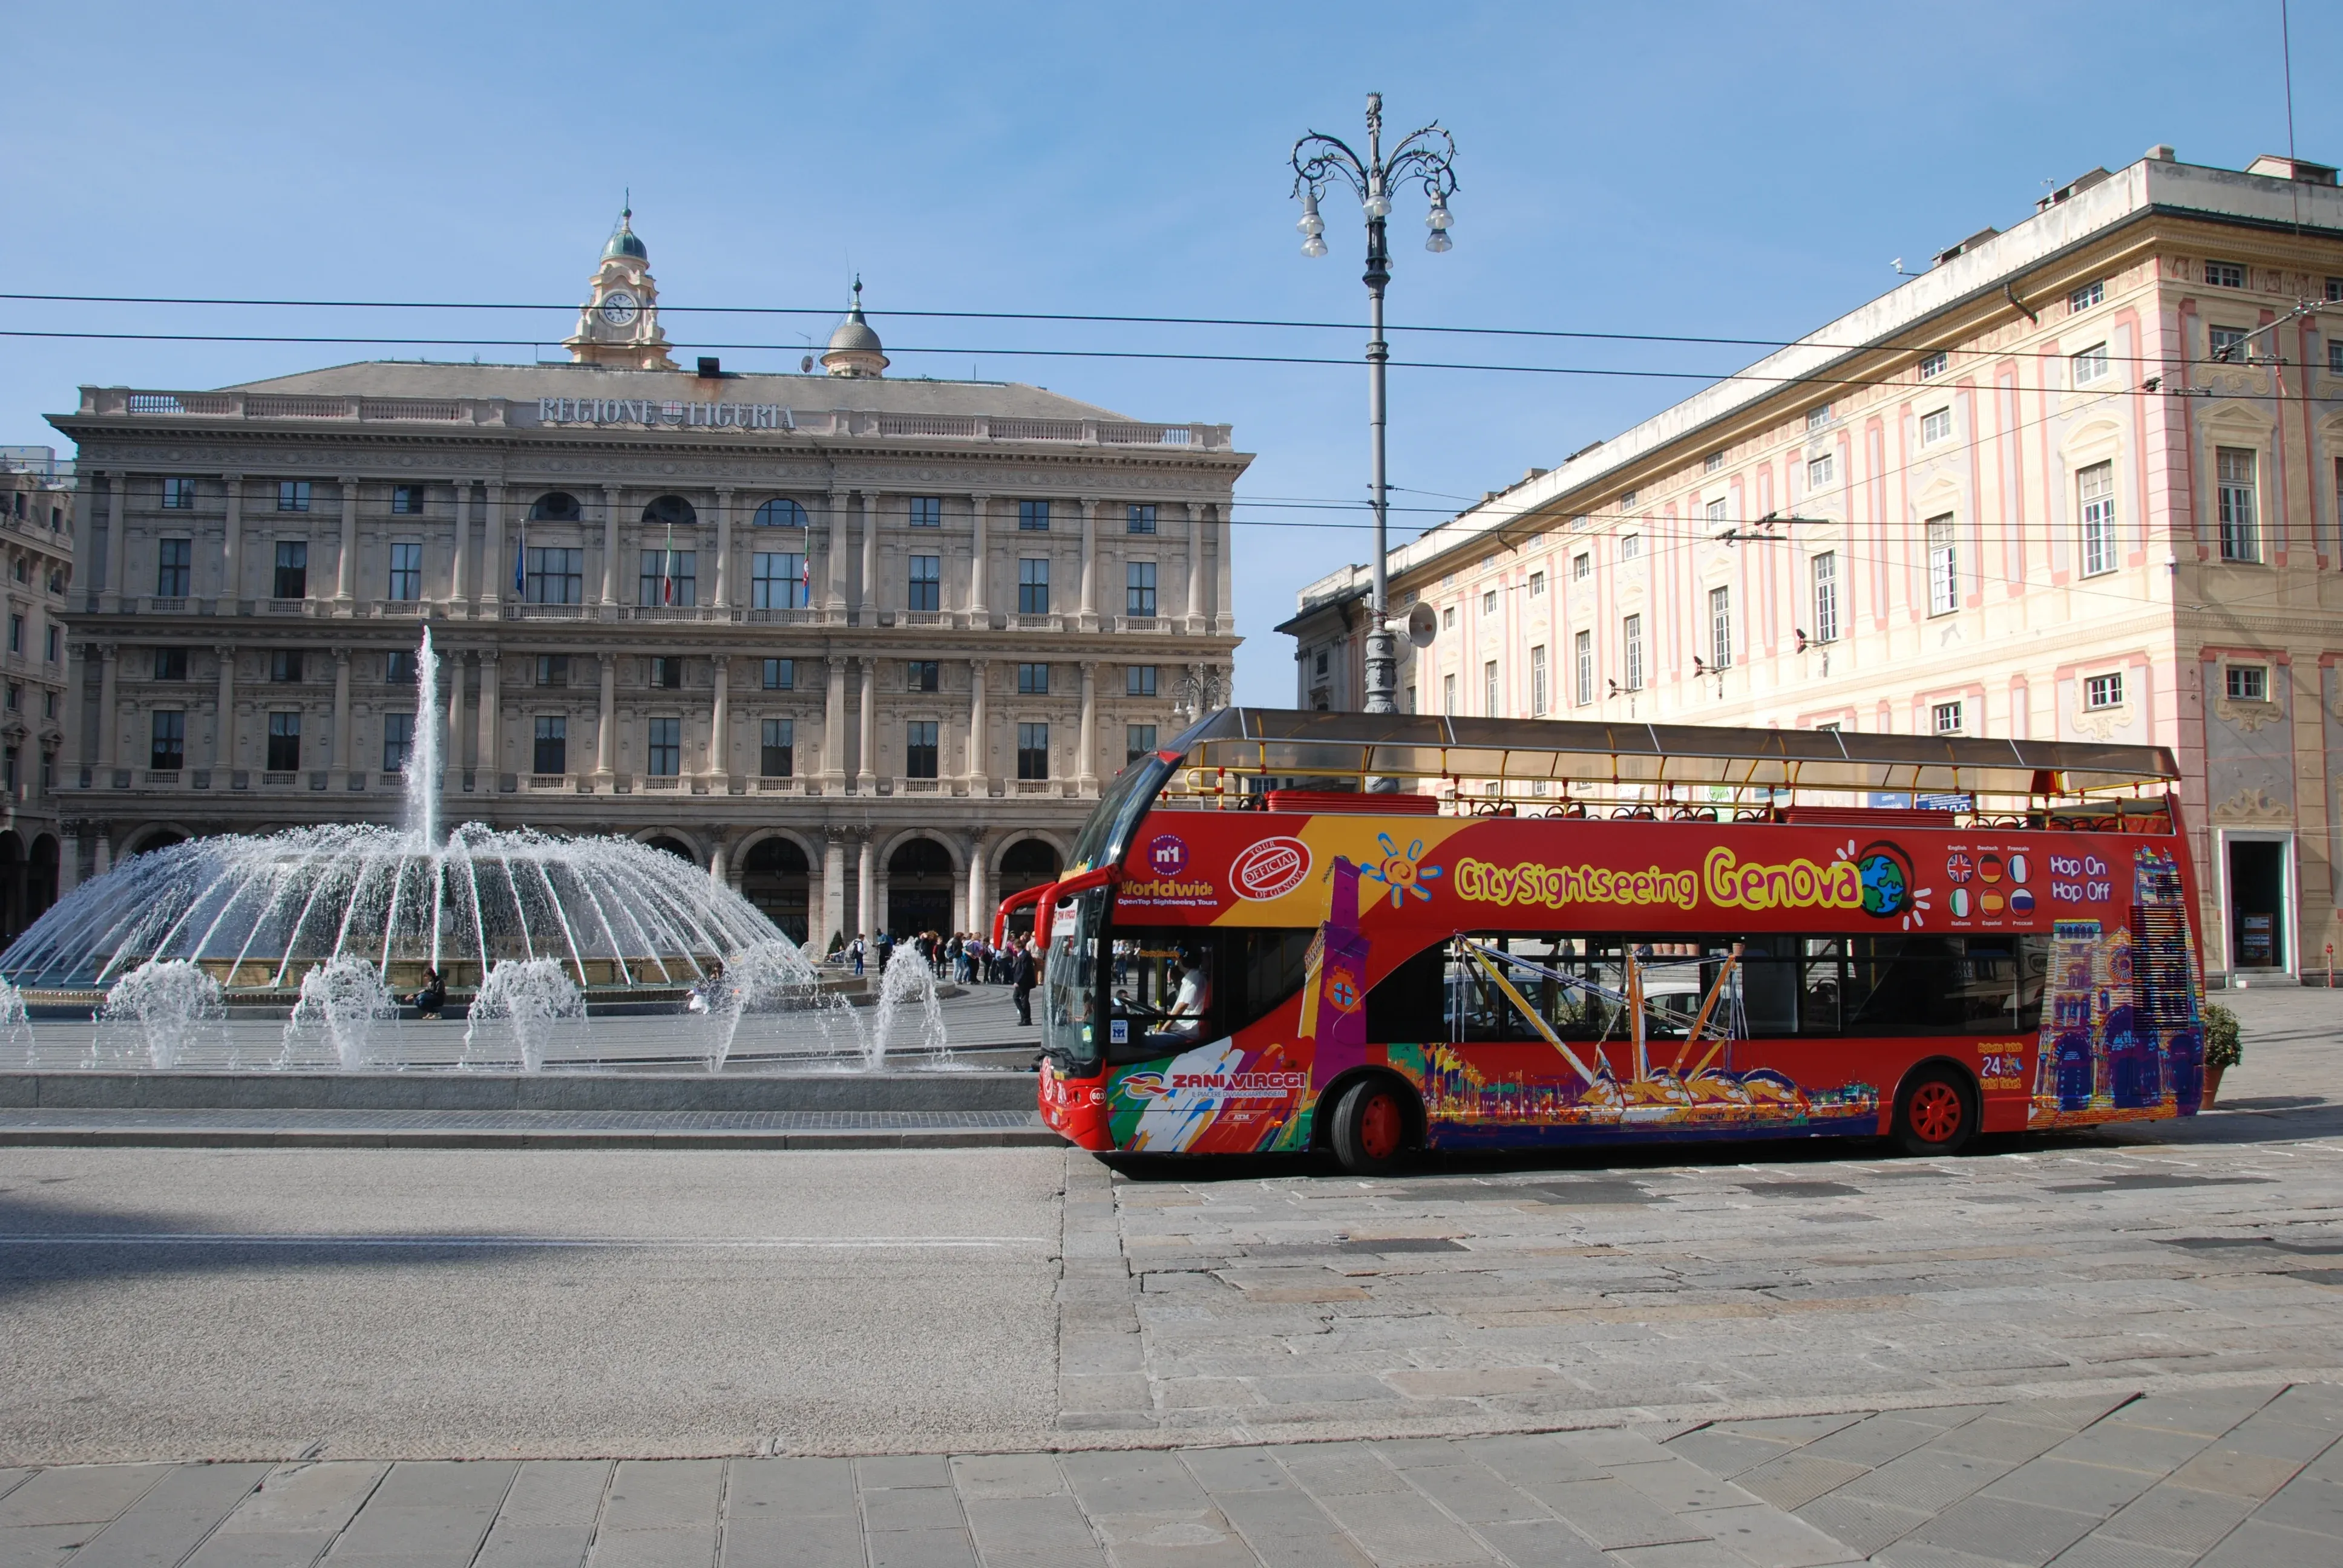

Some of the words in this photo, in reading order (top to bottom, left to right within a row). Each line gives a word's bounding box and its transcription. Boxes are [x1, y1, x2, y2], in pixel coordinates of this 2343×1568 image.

[537, 397, 657, 424] REGIONE
[688, 401, 796, 429] LIGURIA
[1249, 841, 1276, 856] TOUR
[1245, 853, 1297, 882] OFFICIAL
[2050, 856, 2080, 877] Hop
[2085, 856, 2106, 875] On
[1122, 879, 1213, 897] Worldwide
[1270, 869, 1306, 897] GENOVA
[1705, 846, 1864, 910] Genova
[2053, 881, 2082, 902] Hop
[2087, 881, 2110, 900] Off
[1978, 1042, 2004, 1054] Biglietto
[1981, 1056, 2001, 1077] 24
[1173, 1074, 1225, 1088] ZANI
[1230, 1073, 1306, 1088] VIAGGI
[1980, 1077, 1999, 1089] Valid
[1999, 1077, 2022, 1089] Ticket
